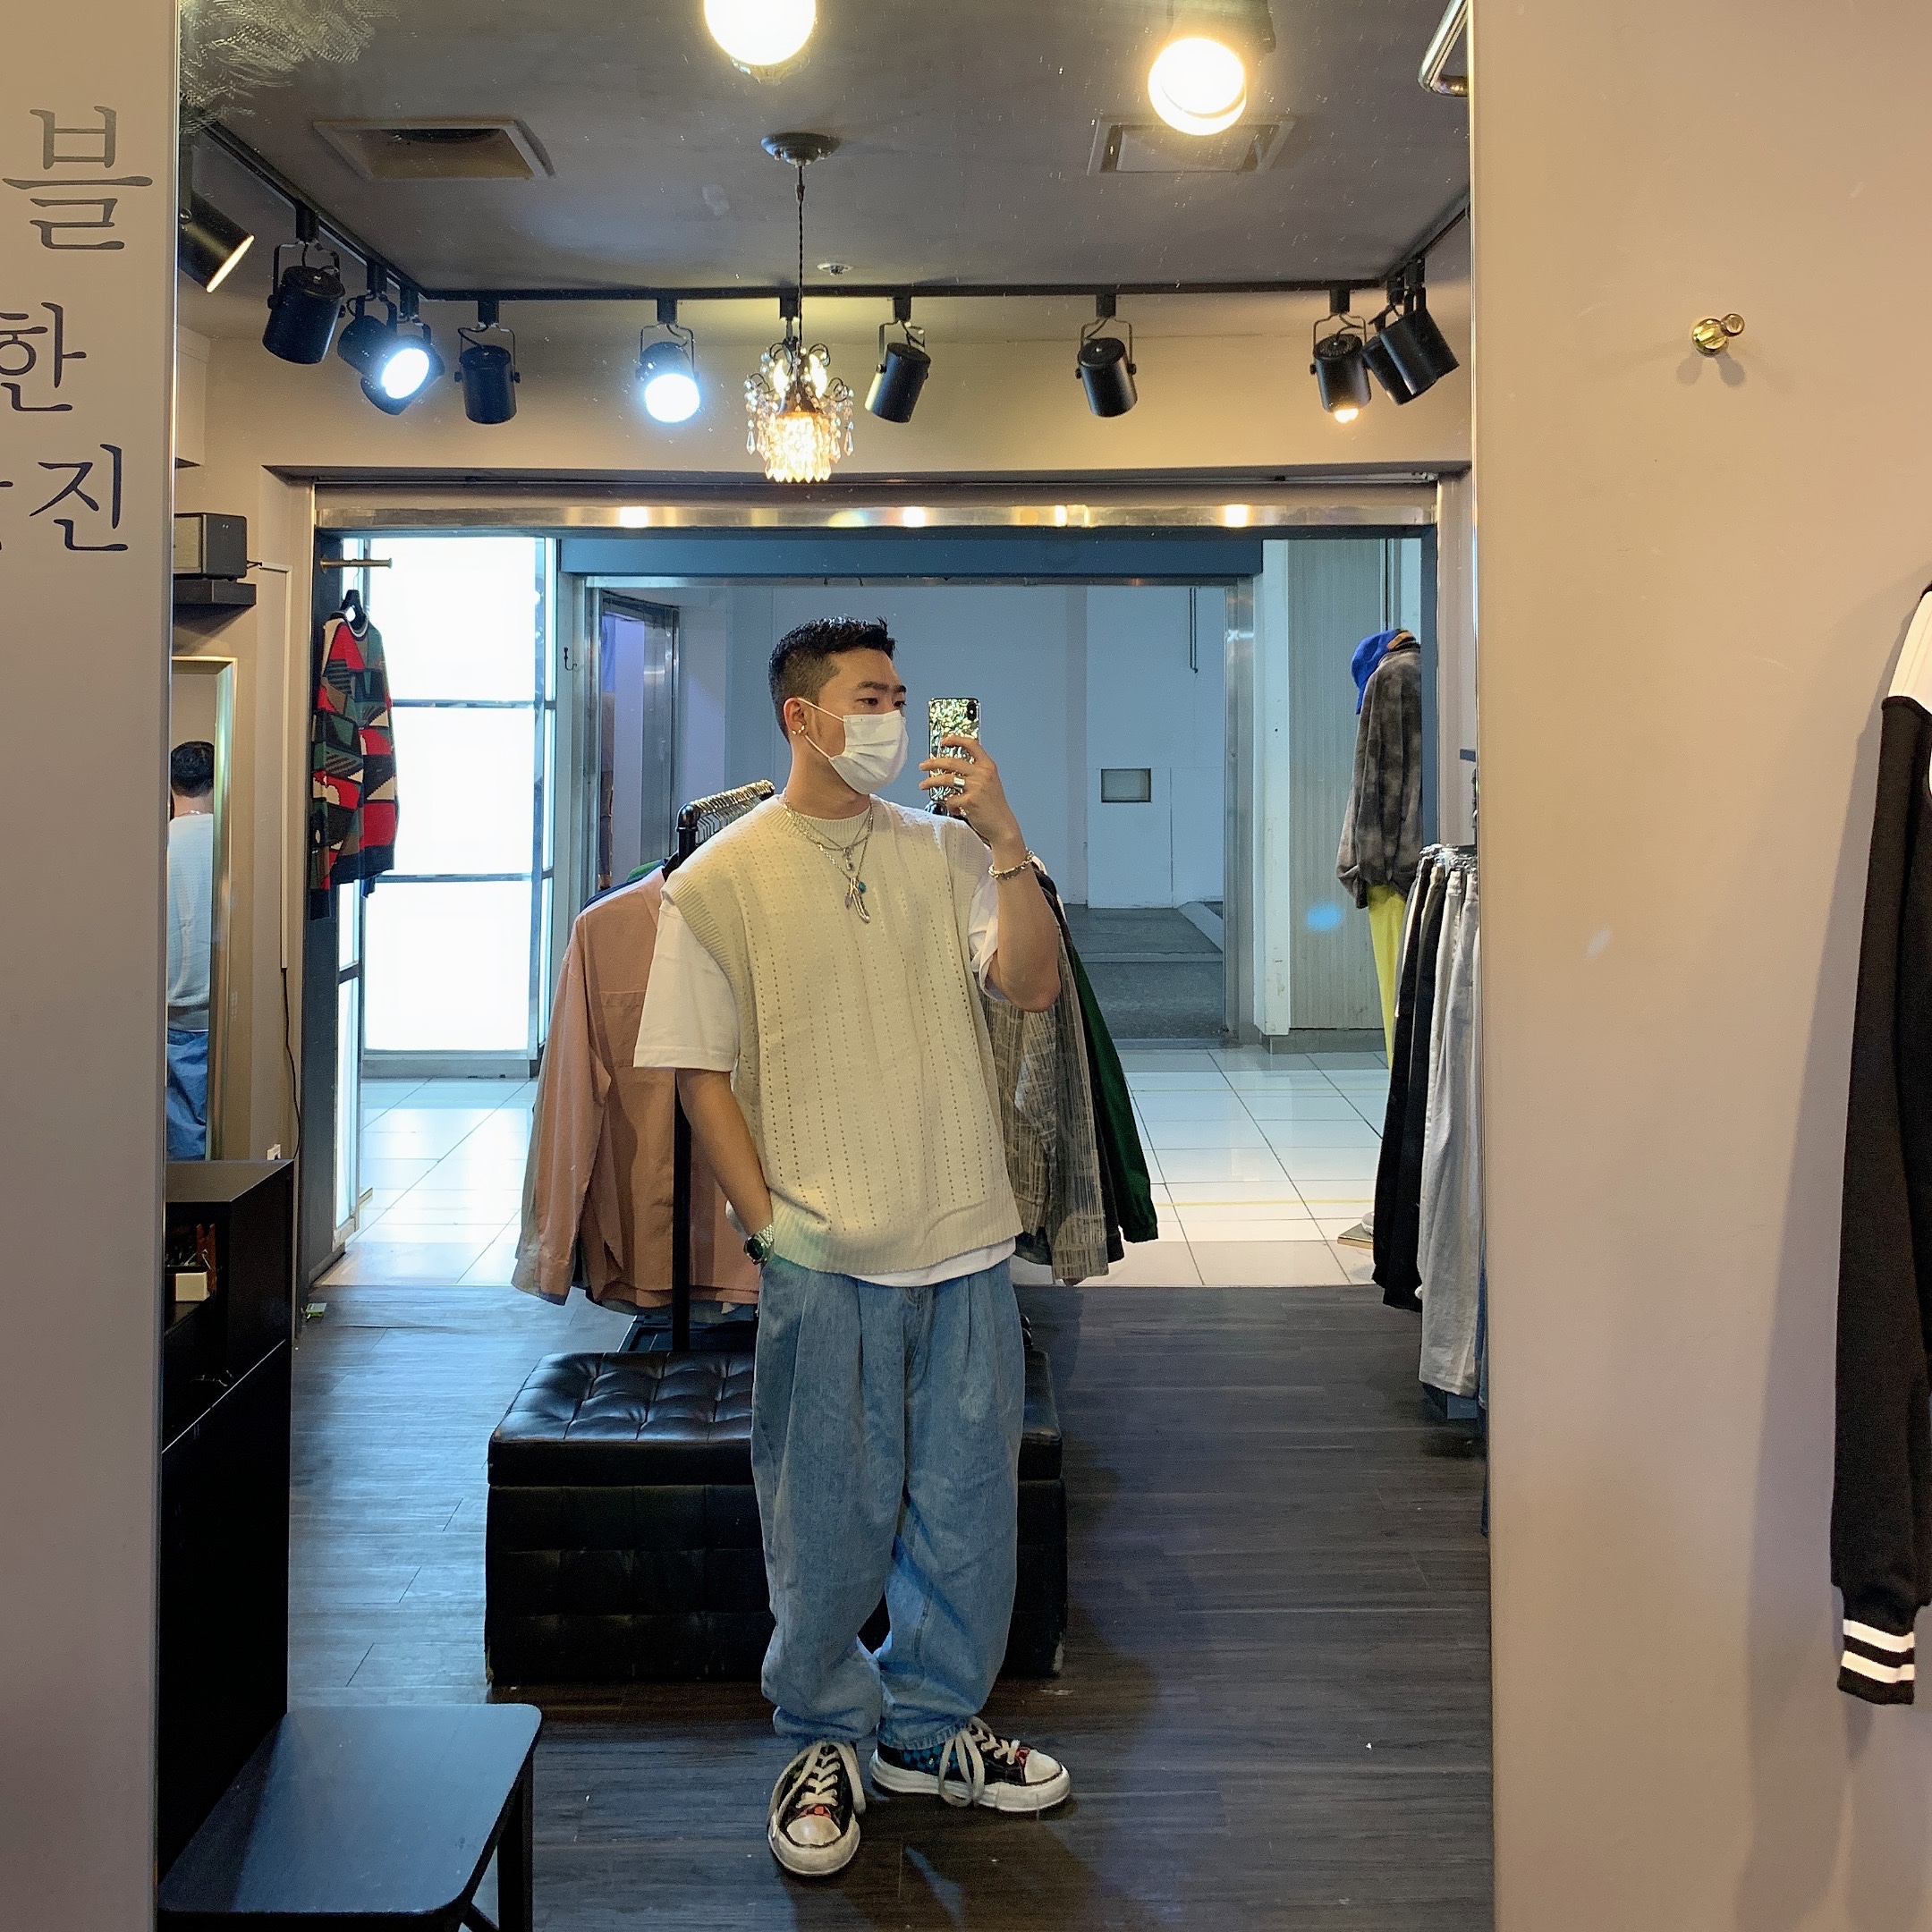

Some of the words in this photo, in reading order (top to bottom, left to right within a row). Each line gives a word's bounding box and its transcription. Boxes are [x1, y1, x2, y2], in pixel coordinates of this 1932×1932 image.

[2, 105, 153, 250] 블
[0, 301, 87, 411] 한
[0, 443, 129, 552] 진
